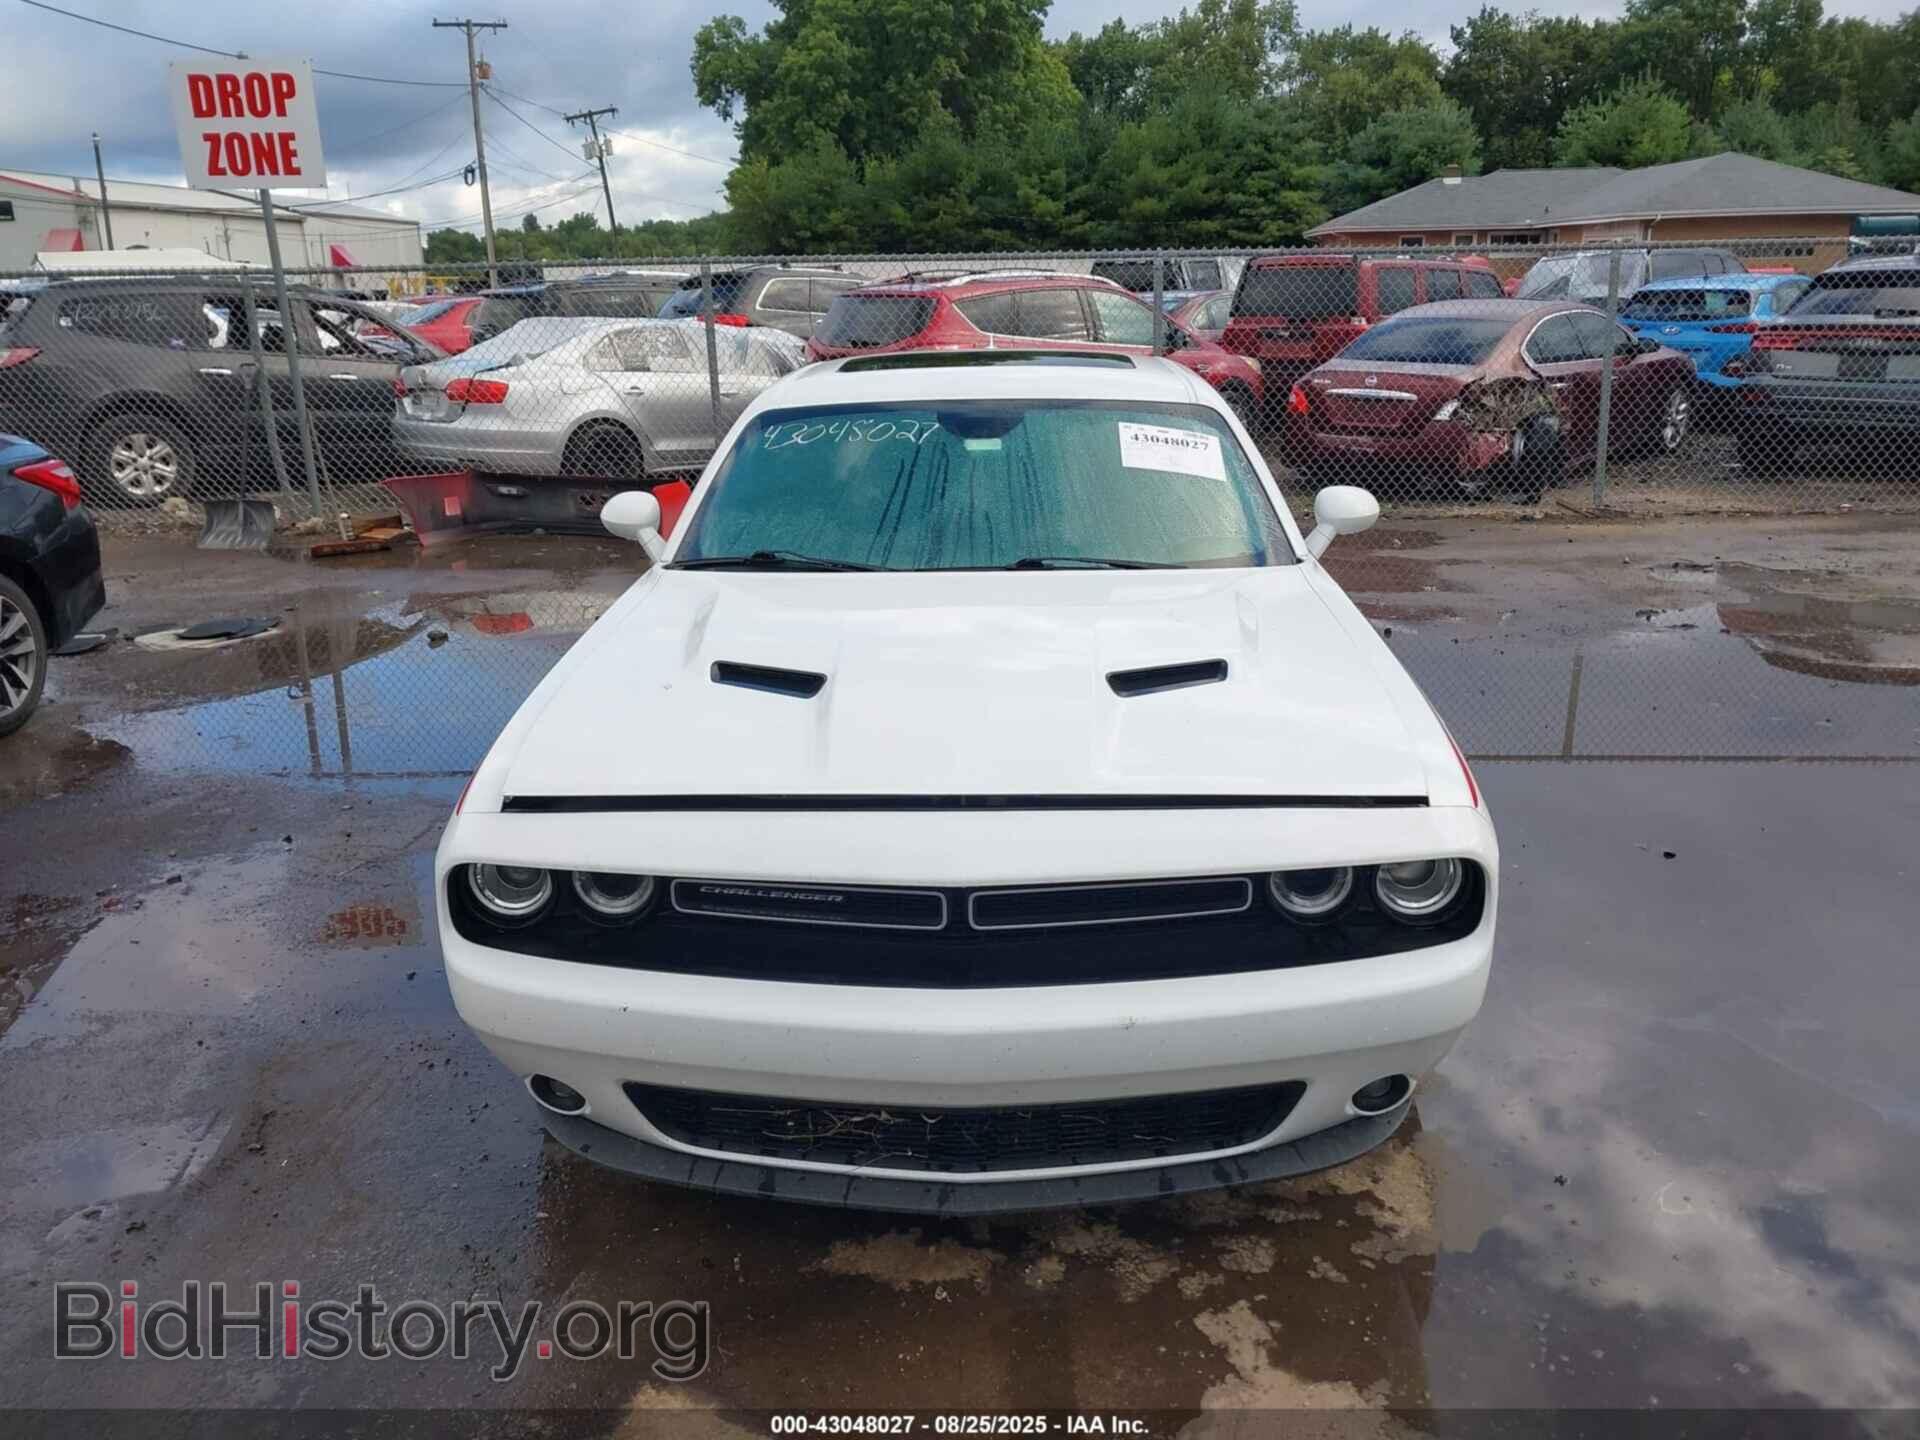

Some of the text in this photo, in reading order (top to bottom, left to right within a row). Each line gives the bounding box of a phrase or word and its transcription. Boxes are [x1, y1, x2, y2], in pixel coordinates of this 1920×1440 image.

[187, 72, 296, 118] DROP
[202, 132, 302, 176] ZONE
[1130, 433, 1209, 451] 43048027
[700, 886, 844, 902] CHALLENGER
